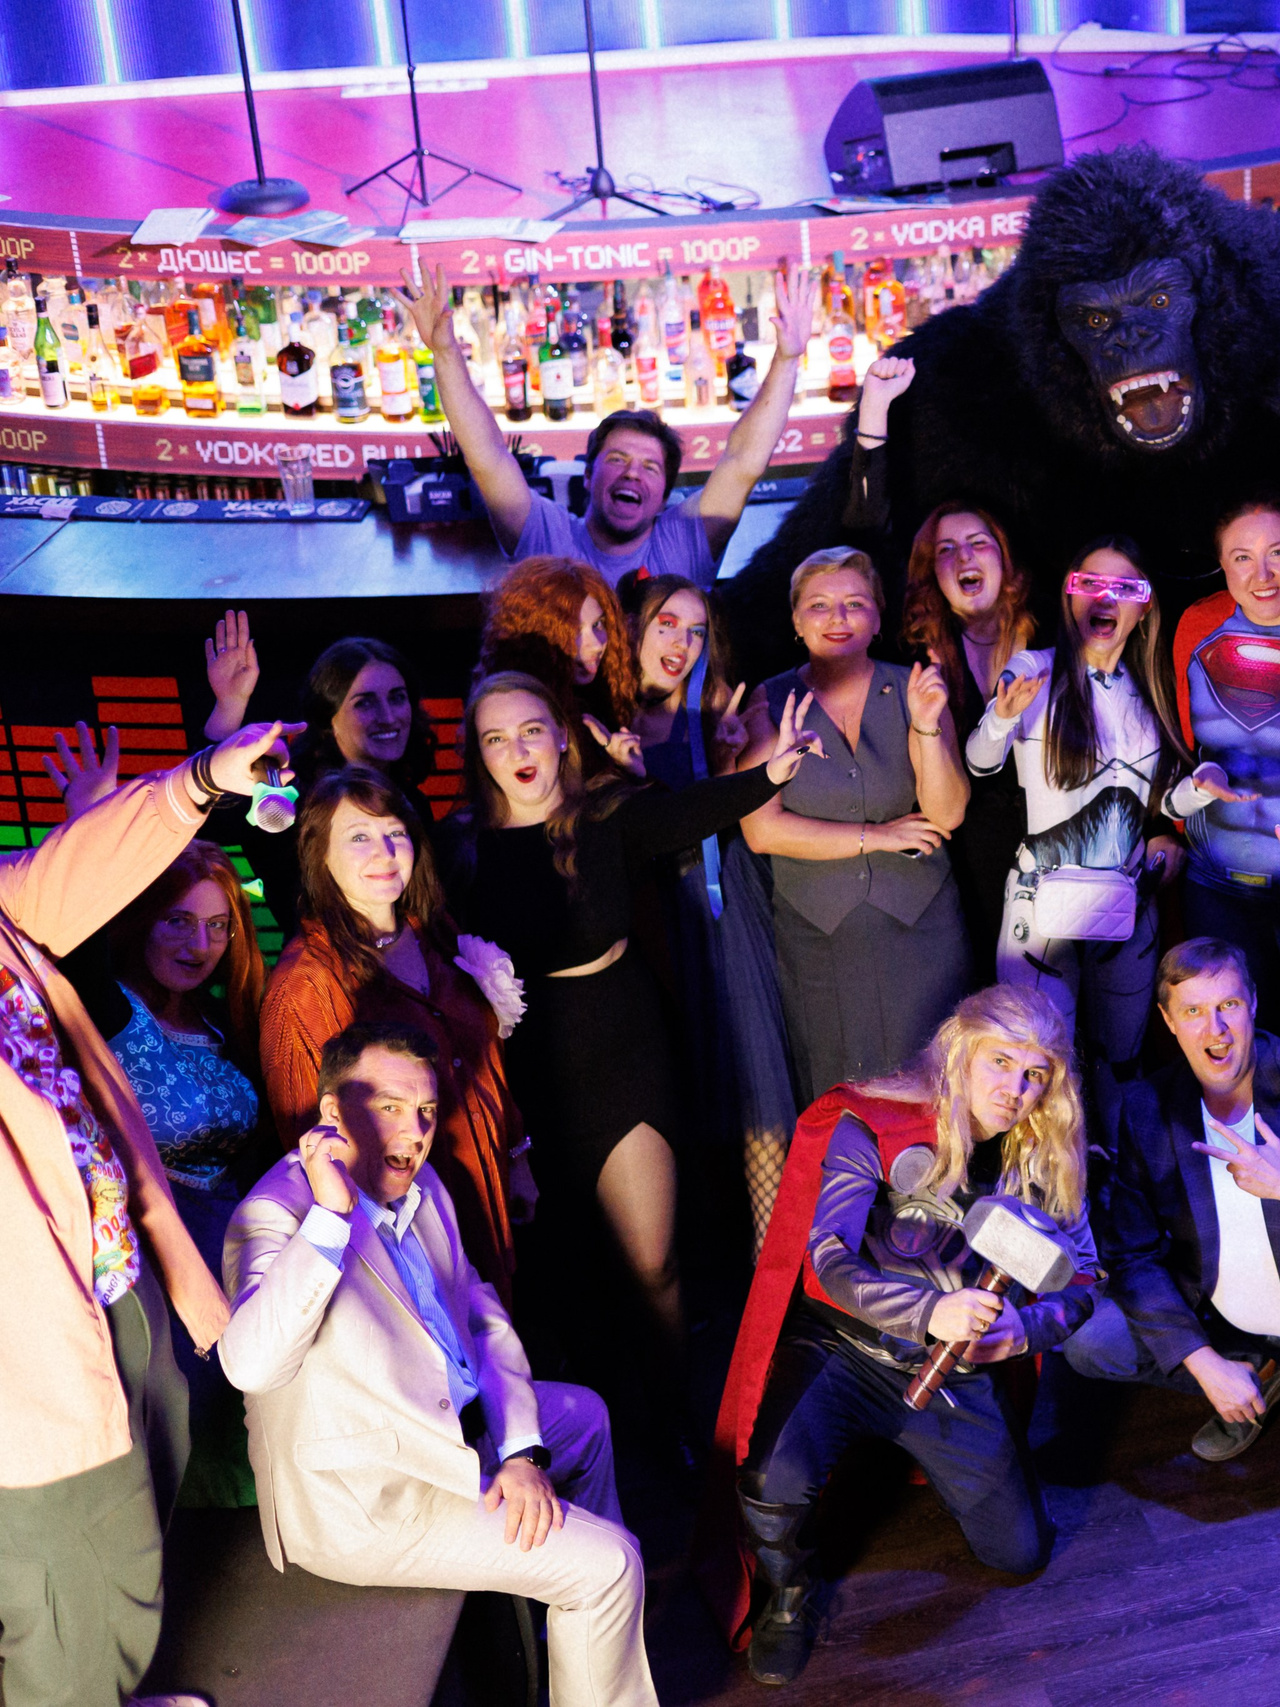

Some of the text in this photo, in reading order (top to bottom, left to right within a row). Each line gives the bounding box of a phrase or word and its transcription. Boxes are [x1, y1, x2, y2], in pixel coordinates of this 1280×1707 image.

[891, 215, 985, 247] VODKA
[157, 248, 263, 274] ДЮШЕС
[504, 242, 651, 273] GIN-TONIC
